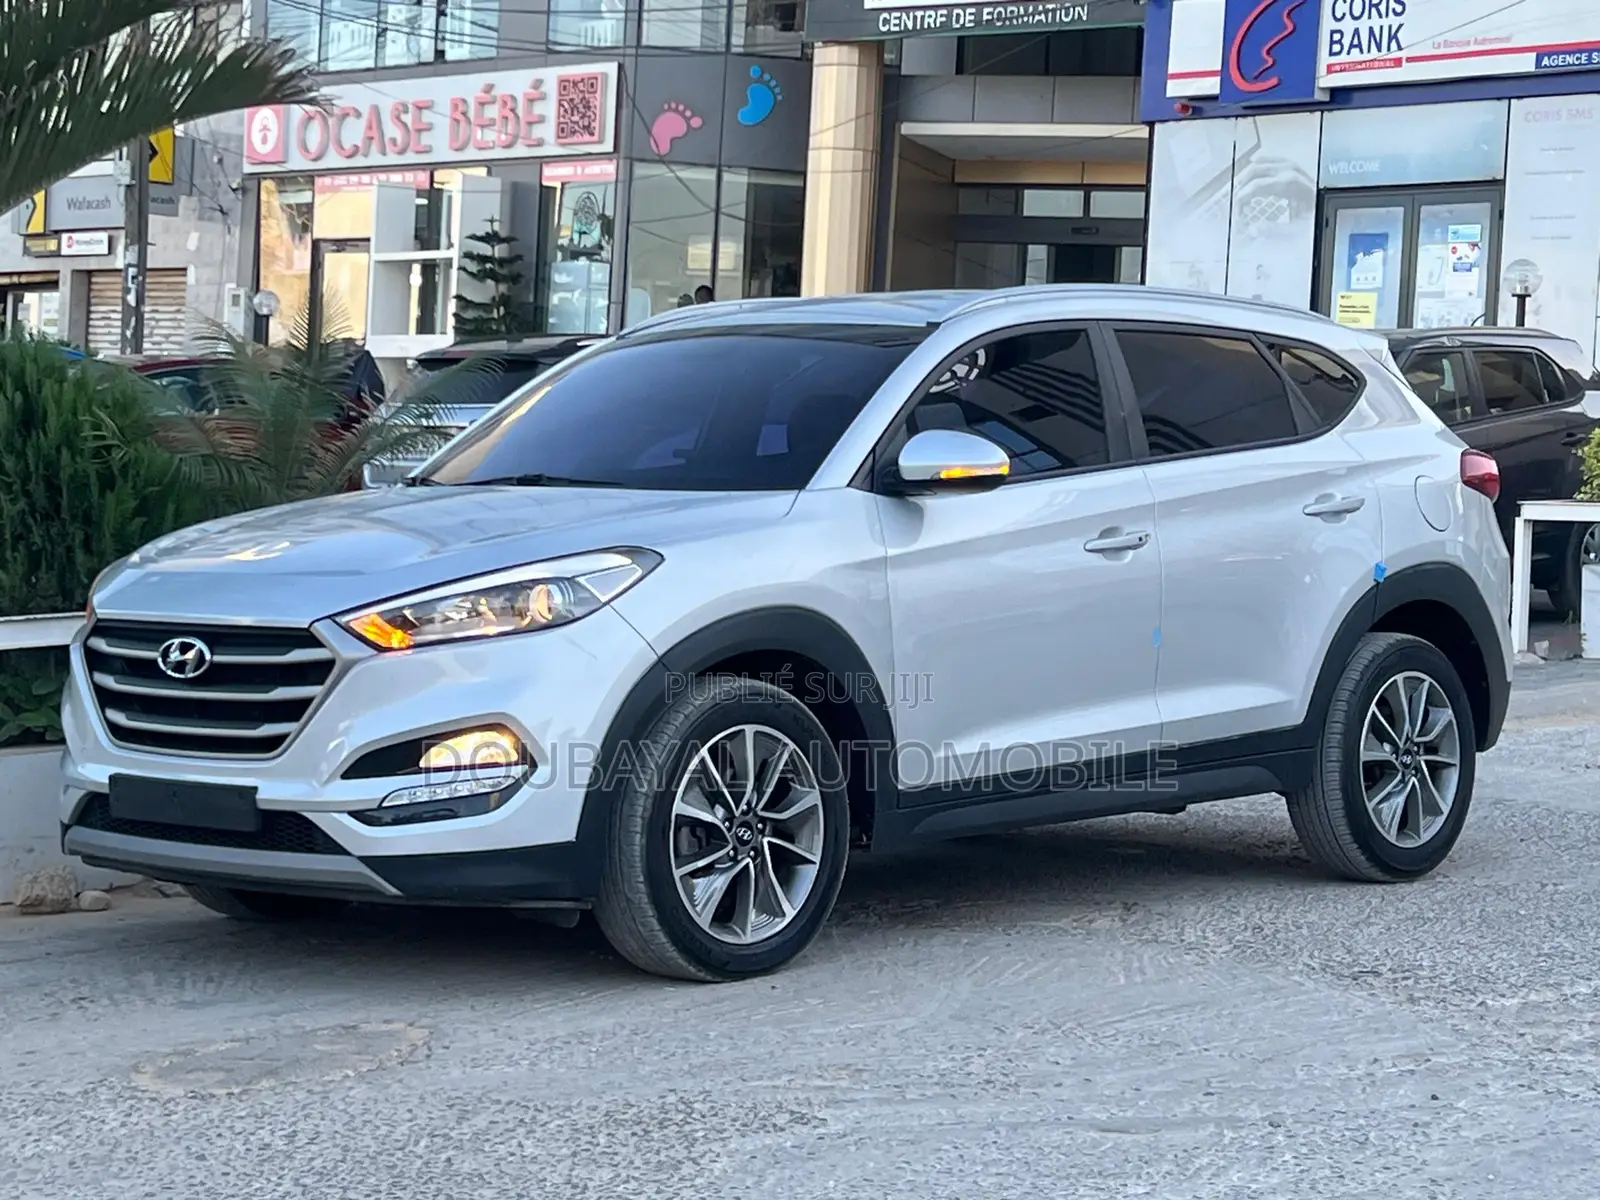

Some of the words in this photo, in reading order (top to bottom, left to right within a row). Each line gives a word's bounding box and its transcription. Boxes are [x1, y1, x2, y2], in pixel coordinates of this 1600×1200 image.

[878, 9, 948, 32] CENTRE
[952, 8, 977, 28] DE
[982, 3, 1088, 27] FORMATION
[1331, 0, 1406, 22] CORIS
[1328, 22, 1405, 57] BANK
[1541, 53, 1589, 67] AGENCE
[1591, 51, 1600, 64] S
[297, 99, 434, 162] OCASE
[449, 78, 546, 151] BÉBÉ
[1524, 108, 1563, 123] CORIS
[1566, 107, 1594, 121] SMS
[1328, 160, 1380, 175] WELCOME
[66, 196, 112, 211] Wafacash
